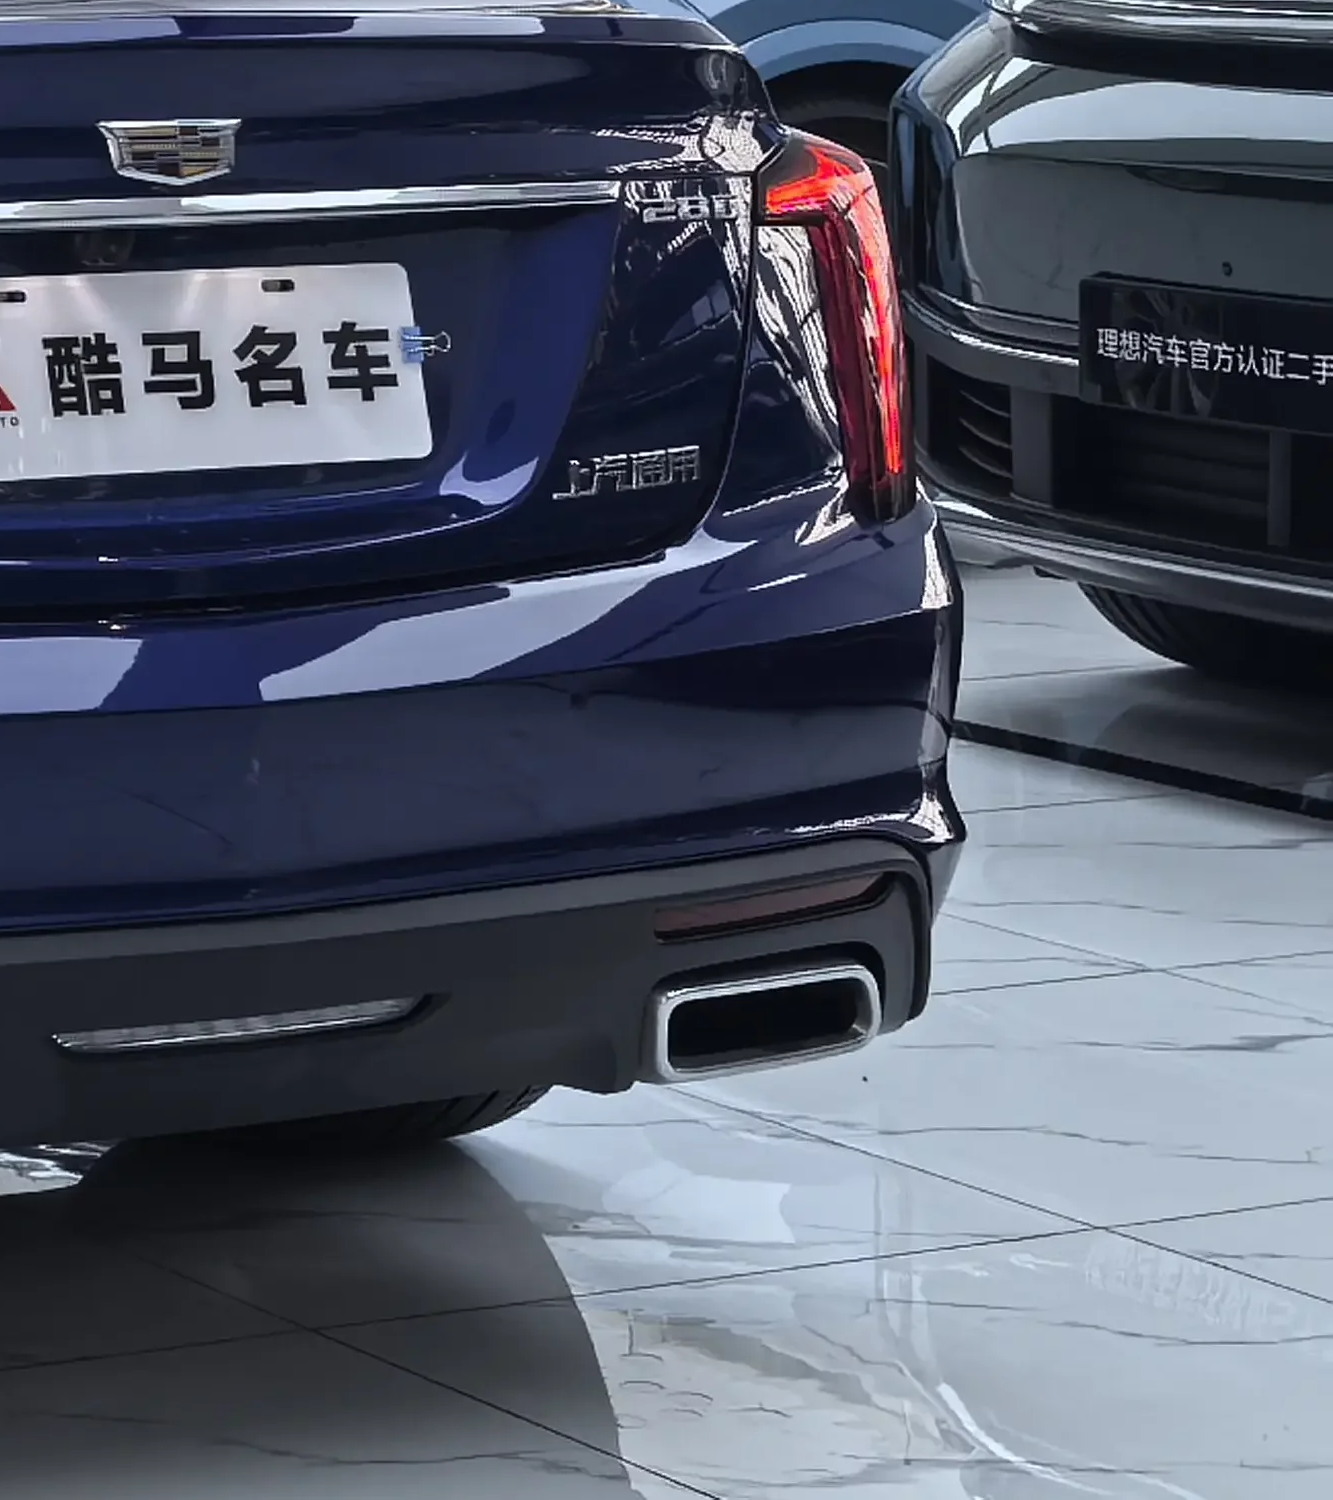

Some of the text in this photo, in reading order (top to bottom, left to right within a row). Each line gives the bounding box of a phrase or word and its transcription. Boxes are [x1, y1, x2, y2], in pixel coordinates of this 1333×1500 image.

[42, 321, 399, 418] 酷马名车
[1097, 328, 1333, 385] 理想汽车官方认证二手
